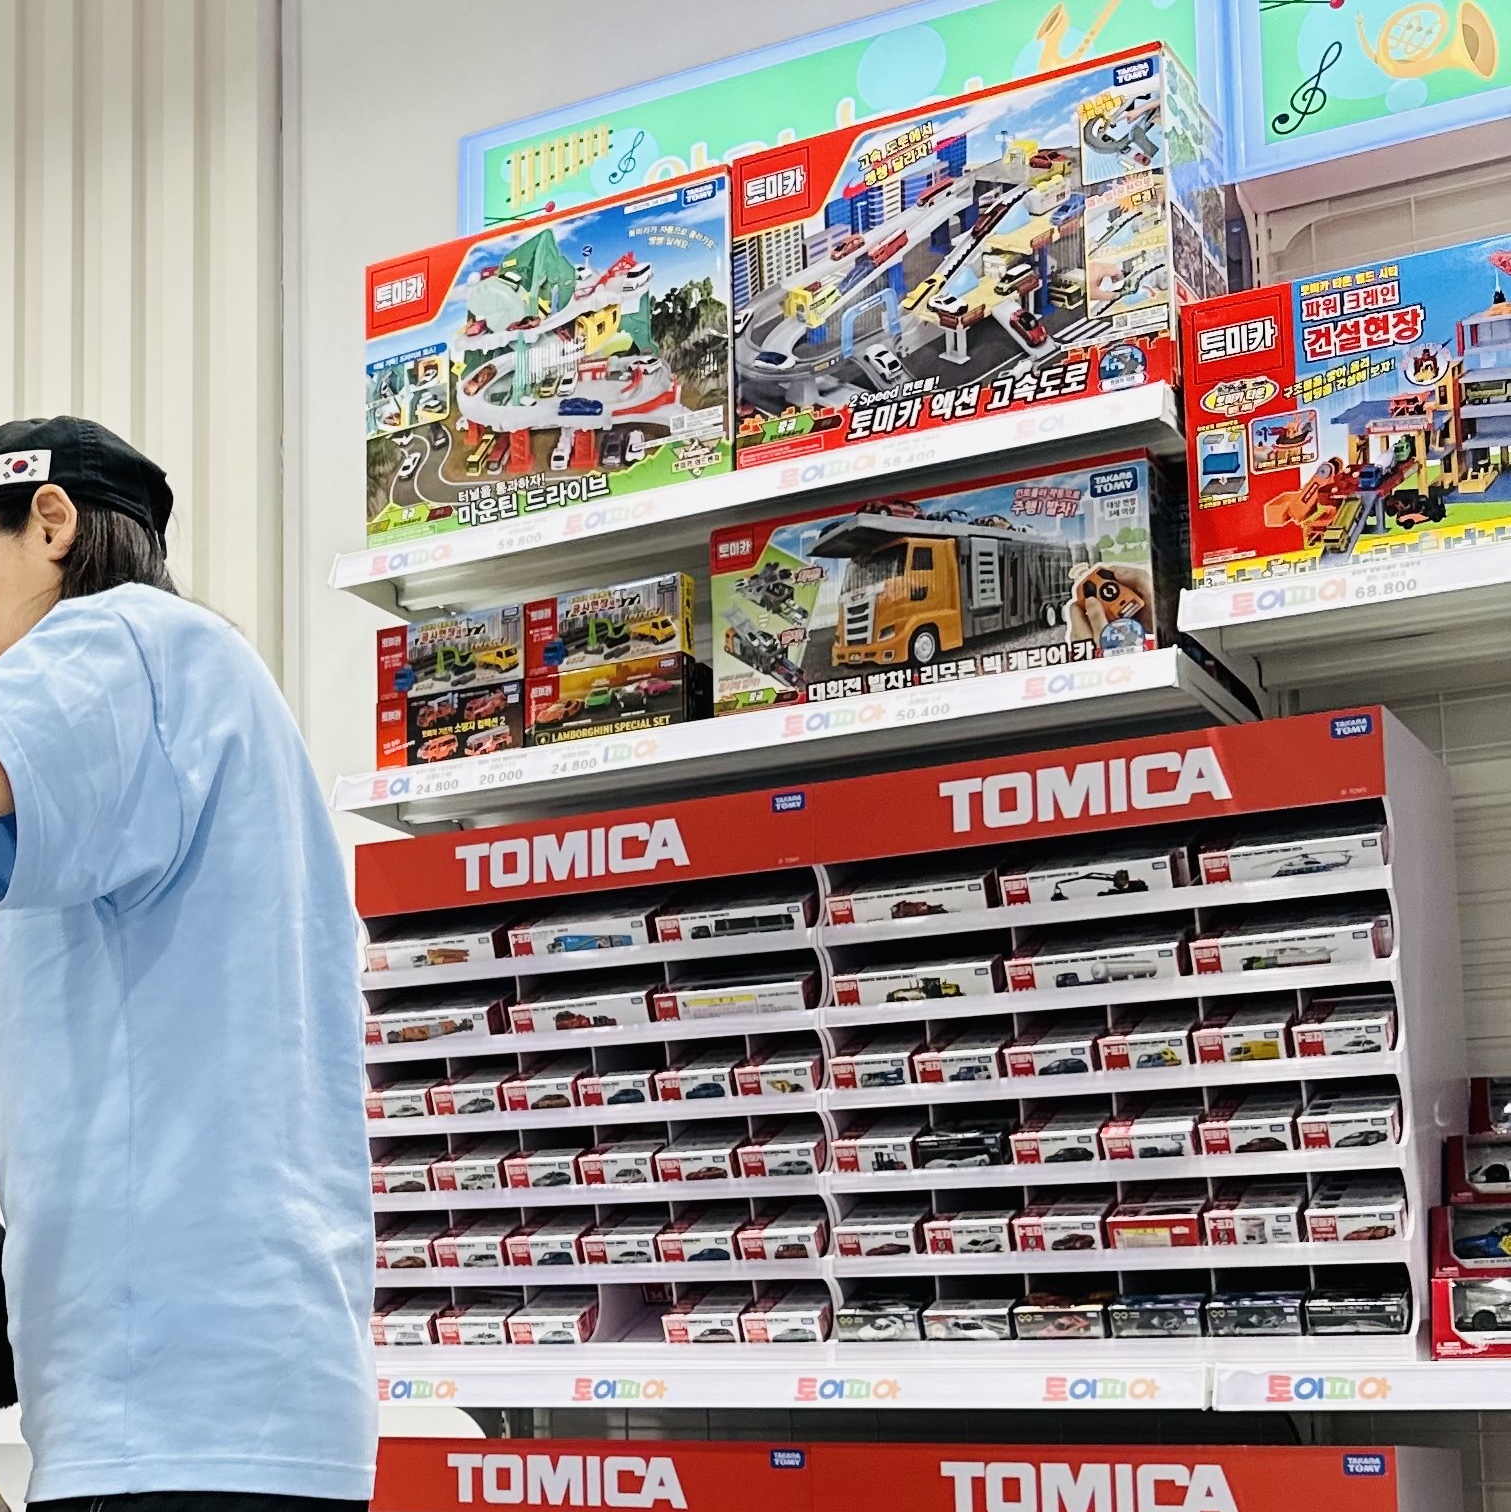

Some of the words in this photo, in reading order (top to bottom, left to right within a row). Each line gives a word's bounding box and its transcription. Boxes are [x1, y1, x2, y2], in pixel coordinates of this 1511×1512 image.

[1116, 69, 1149, 85] TOMY
[884, 121, 934, 155] 도로에서
[891, 140, 933, 172] 달리자!
[686, 190, 713, 202] TOMY
[745, 165, 806, 208] 토미카
[374, 272, 426, 312] 토미카
[1305, 296, 1338, 317] 파워
[1347, 284, 1396, 310] 크레인
[1198, 318, 1277, 361] 토미카
[1306, 308, 1421, 359] 건설현장
[845, 402, 922, 440] 토미카
[930, 382, 981, 419] 액션
[986, 362, 1088, 411] 고속도로
[847, 393, 859, 408] 2
[859, 383, 899, 407] Speed
[458, 484, 492, 503] 터널을
[495, 474, 546, 495] 통과하자!
[1094, 471, 1133, 483] TAKARA
[1094, 480, 1133, 493] TOMY
[457, 496, 518, 526] 마운틴
[525, 474, 610, 513] 드라이브
[716, 538, 752, 560] 토미카
[808, 675, 862, 703] 대회전
[868, 669, 912, 696] 발차!
[920, 660, 976, 687] 리모콘
[983, 656, 1002, 678] 빅
[1007, 646, 1066, 675] 캐리어
[1071, 641, 1094, 664] 카
[551, 723, 614, 743] LAMBORGHINI
[615, 719, 651, 734] SPECIAL
[653, 715, 671, 727] SET
[1333, 718, 1370, 729] TAKARA
[1334, 725, 1369, 736] TOMY
[939, 746, 1234, 833] TOMICA
[774, 800, 802, 811] TOMY
[455, 819, 690, 892] TOMICA
[572, 1377, 669, 1401] 토이피아
[794, 1377, 902, 1401] 토이피아
[1042, 1376, 1159, 1402] 토이피아
[1265, 1375, 1392, 1403] 토이피아
[773, 1457, 802, 1467] TOMY
[1347, 1456, 1382, 1466] TAKARA
[1347, 1463, 1381, 1474] TOMY
[447, 1453, 688, 1509] TOMICA
